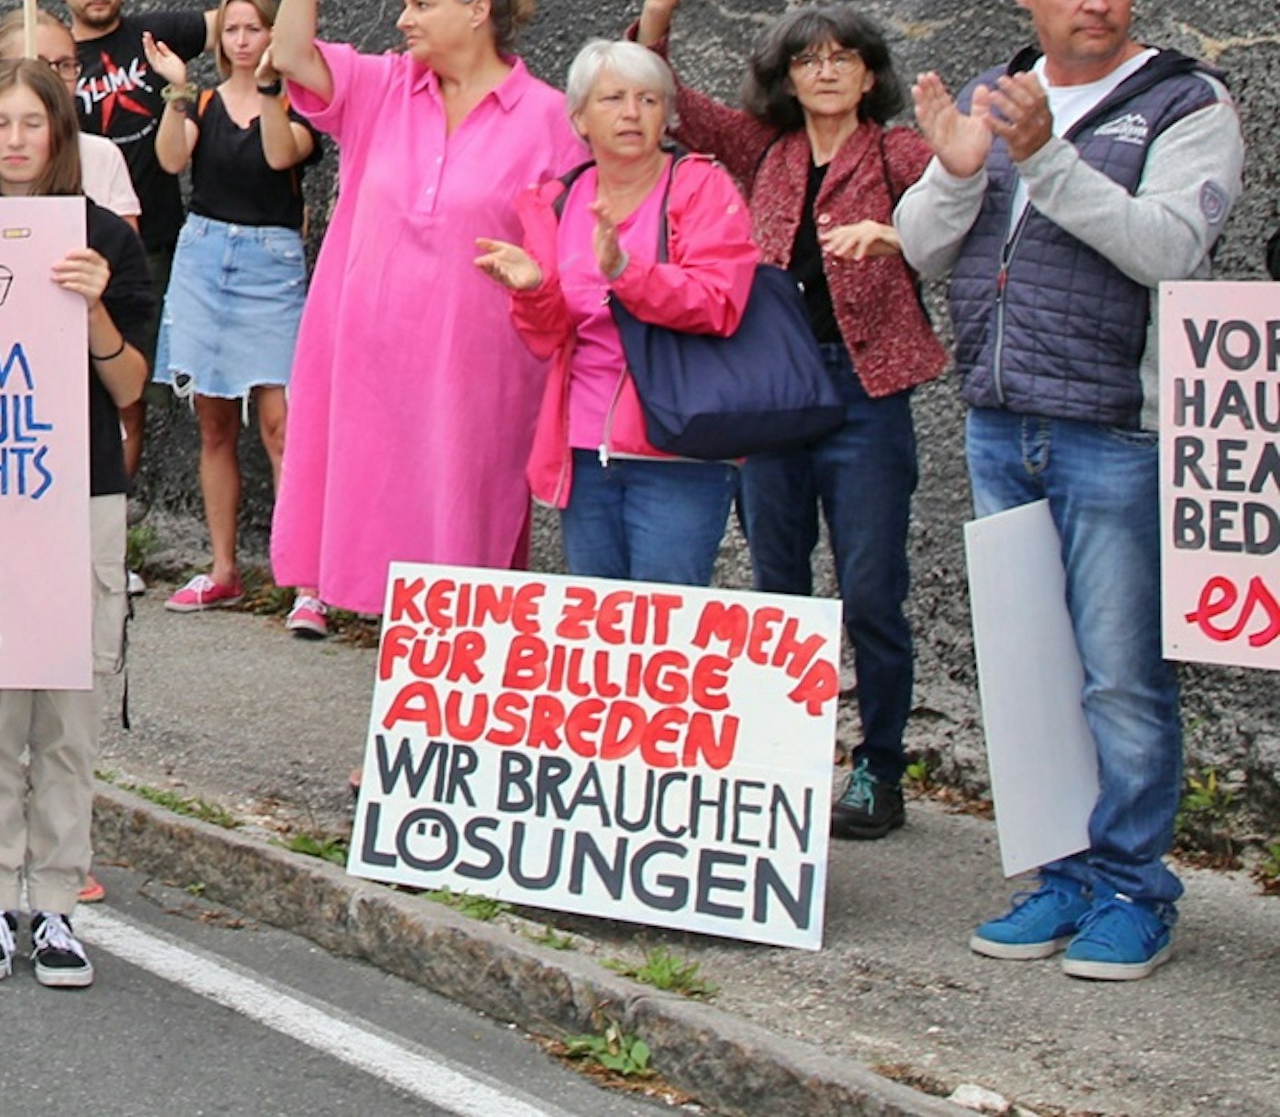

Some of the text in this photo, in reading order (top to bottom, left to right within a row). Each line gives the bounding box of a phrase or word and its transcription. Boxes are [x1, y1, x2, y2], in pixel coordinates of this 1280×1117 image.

[1173, 497, 1280, 555] BED
[379, 625, 734, 711] FÜR BILLIGE
[390, 577, 841, 716] KEINE ZEIT MEHR
[382, 681, 740, 770] AUSREDEN
[375, 734, 813, 853] WIR BRAUCHEN
[361, 802, 815, 930] LÖSUNGEN
